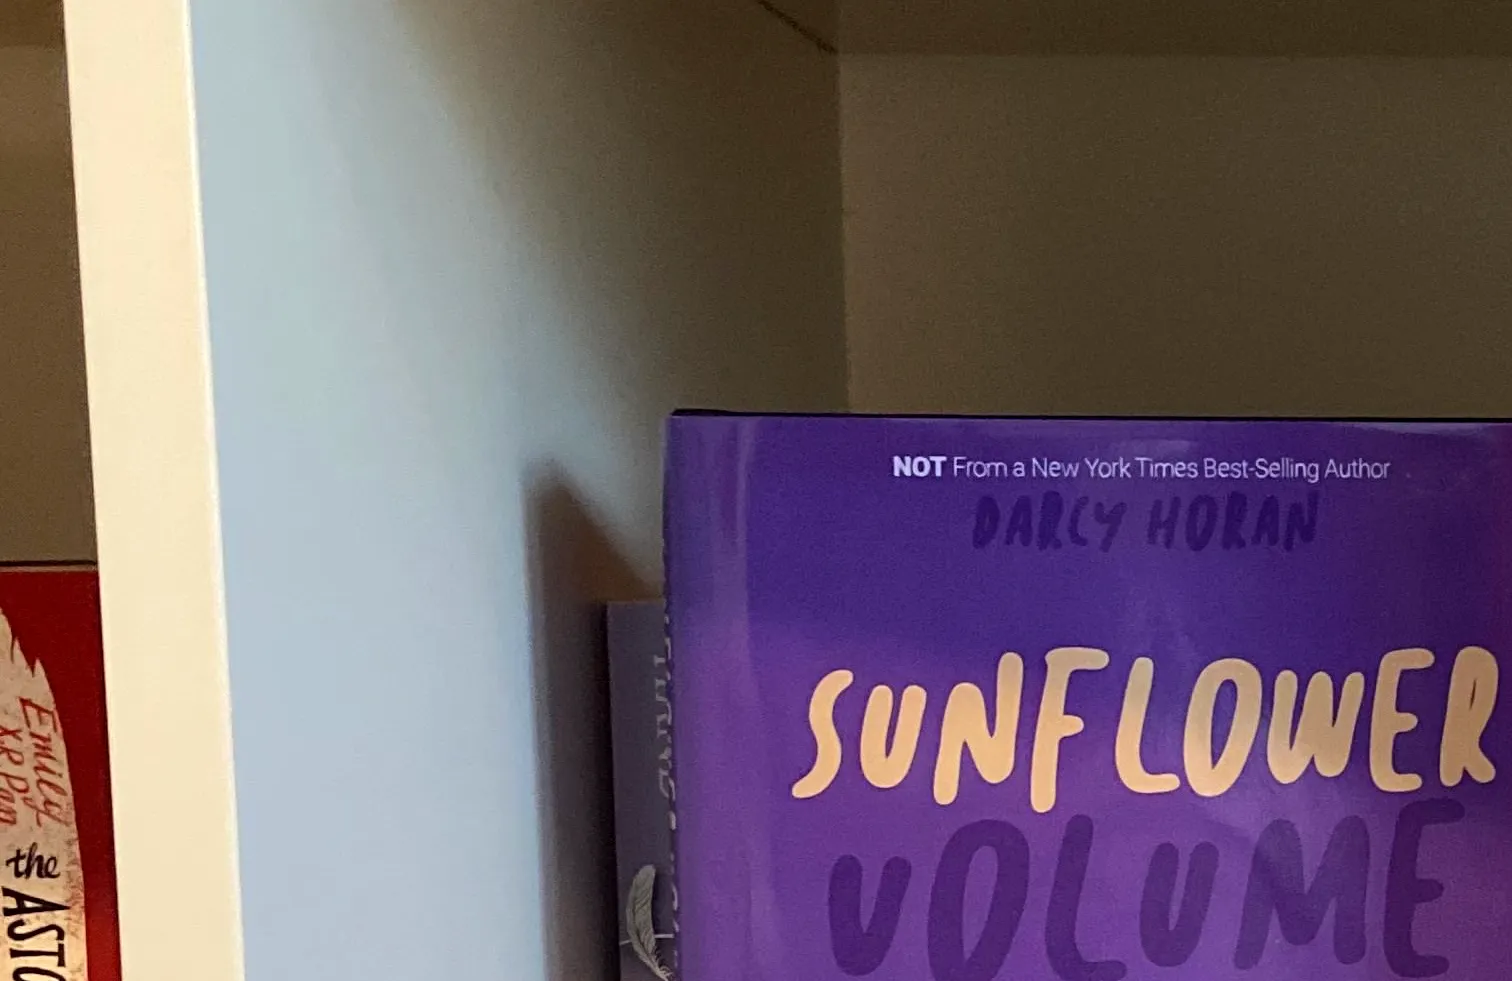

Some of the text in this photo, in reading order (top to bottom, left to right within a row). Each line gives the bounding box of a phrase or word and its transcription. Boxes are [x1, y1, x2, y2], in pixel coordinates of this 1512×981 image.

[893, 455, 1391, 484] NOT From a New York Times Best-Selling Author
[971, 490, 1319, 553] DARCY HORAN
[791, 645, 1500, 813] SUNFLOWER
[18, 696, 70, 828] Emily
[5, 841, 61, 880] the
